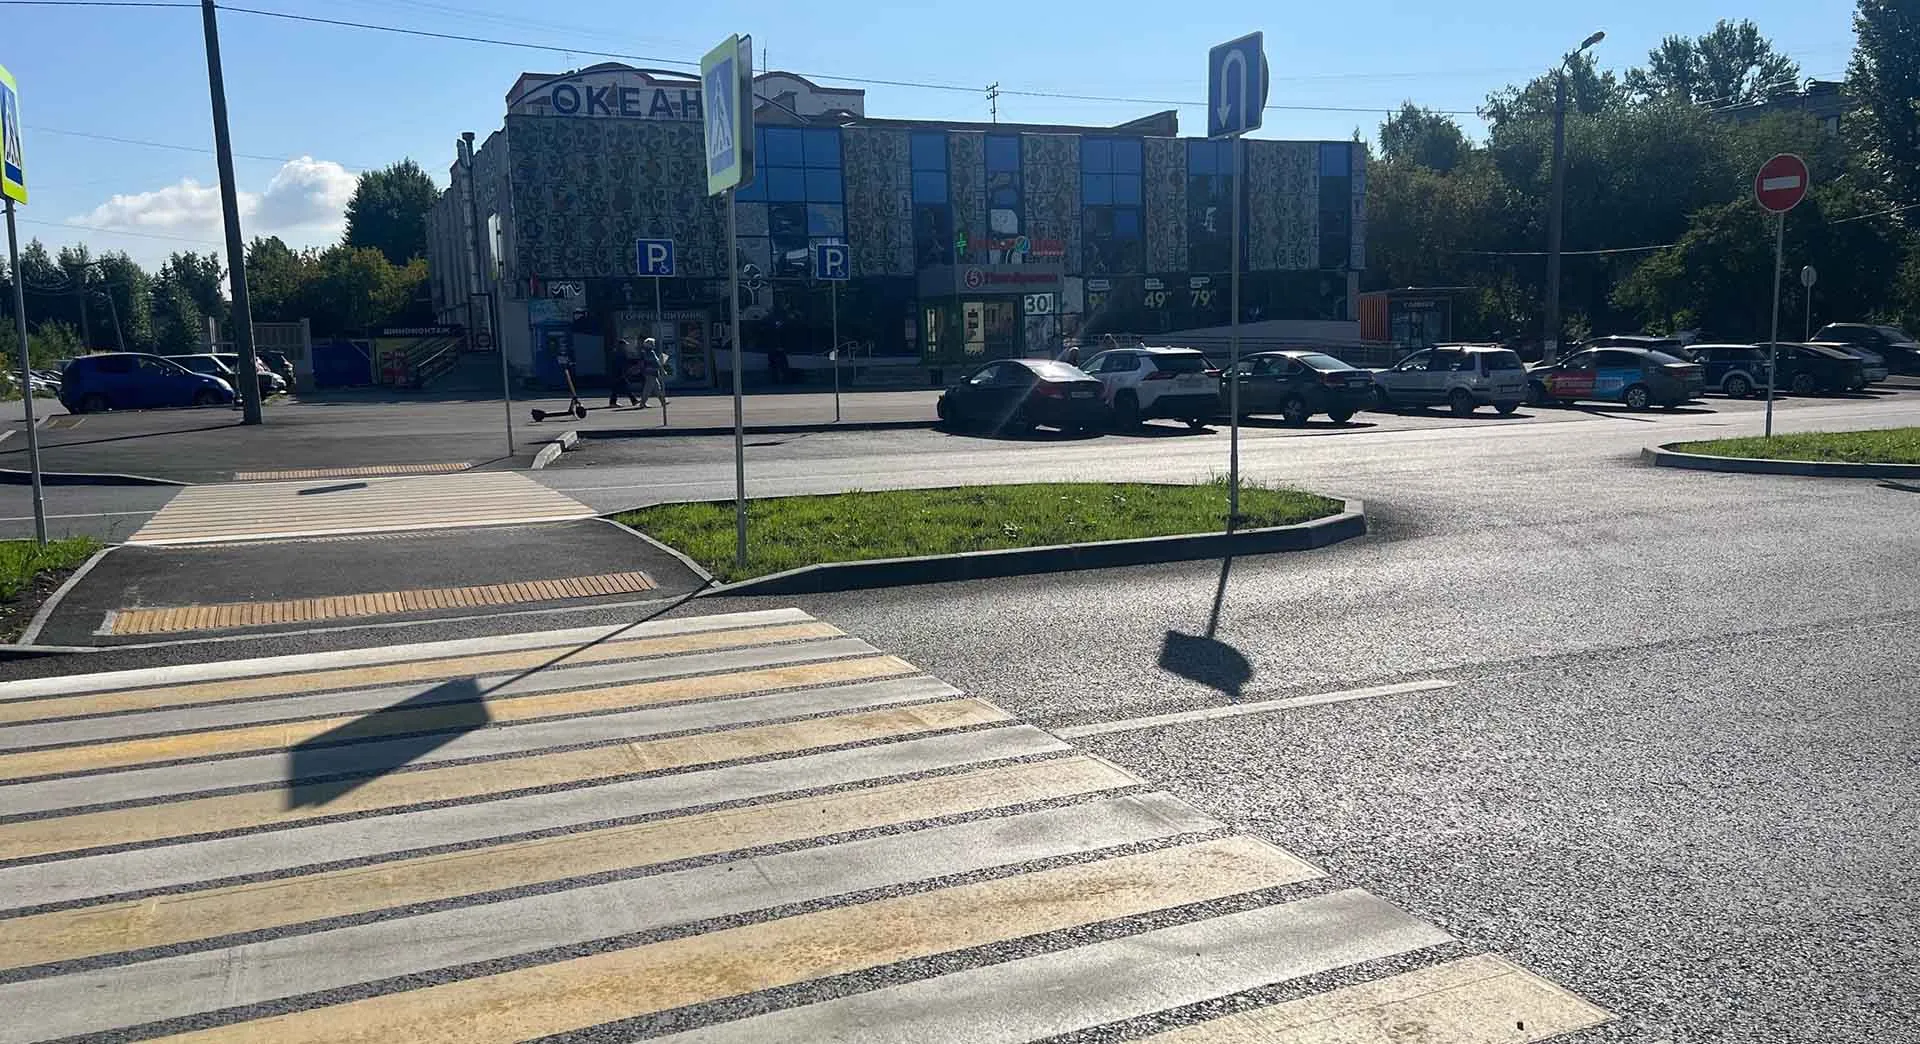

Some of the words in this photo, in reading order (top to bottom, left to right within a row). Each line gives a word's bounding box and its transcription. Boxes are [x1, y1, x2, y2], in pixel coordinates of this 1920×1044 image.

[552, 84, 703, 118] ОКЕАН
[647, 244, 667, 272] P
[826, 249, 844, 275] P
